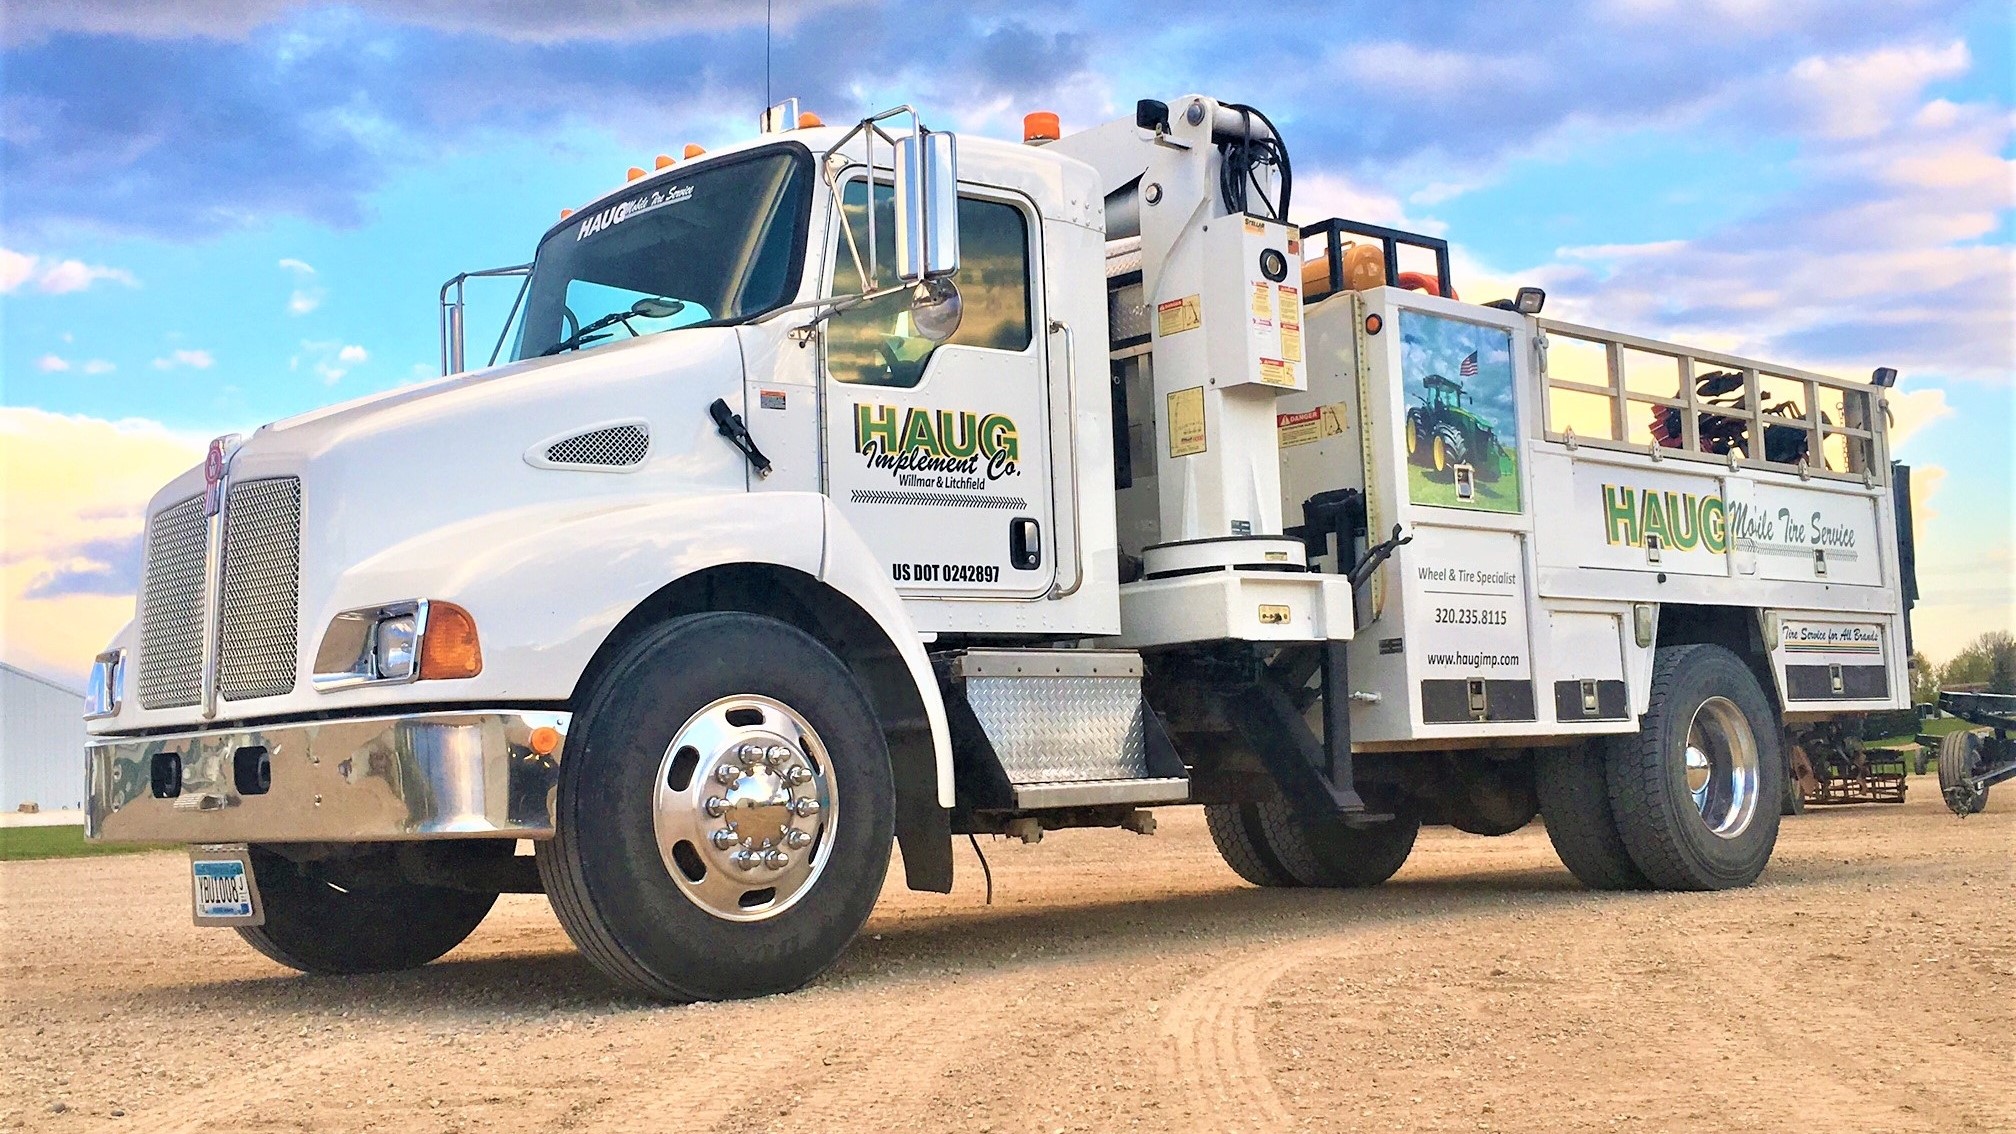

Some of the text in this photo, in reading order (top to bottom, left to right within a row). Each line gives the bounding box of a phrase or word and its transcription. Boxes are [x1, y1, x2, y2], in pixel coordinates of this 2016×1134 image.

[577, 202, 627, 241] HAUG
[1290, 411, 1318, 423] DANGER
[853, 403, 1020, 462] HAUG
[862, 440, 1021, 480] Implement Co.
[899, 474, 986, 490] Willmar & Litchfield
[1601, 483, 1735, 554] HAUG
[1778, 508, 1806, 543] Tire
[1811, 512, 1855, 548] Service
[892, 563, 1000, 582] US DOT 0242897
[1418, 567, 1516, 585] Wheel & Tire Specialist
[1435, 608, 1507, 625] 320.235.8115
[1782, 626, 1879, 644] Tire Service for All Brands
[1427, 651, 1519, 668] www.haugimp.com
